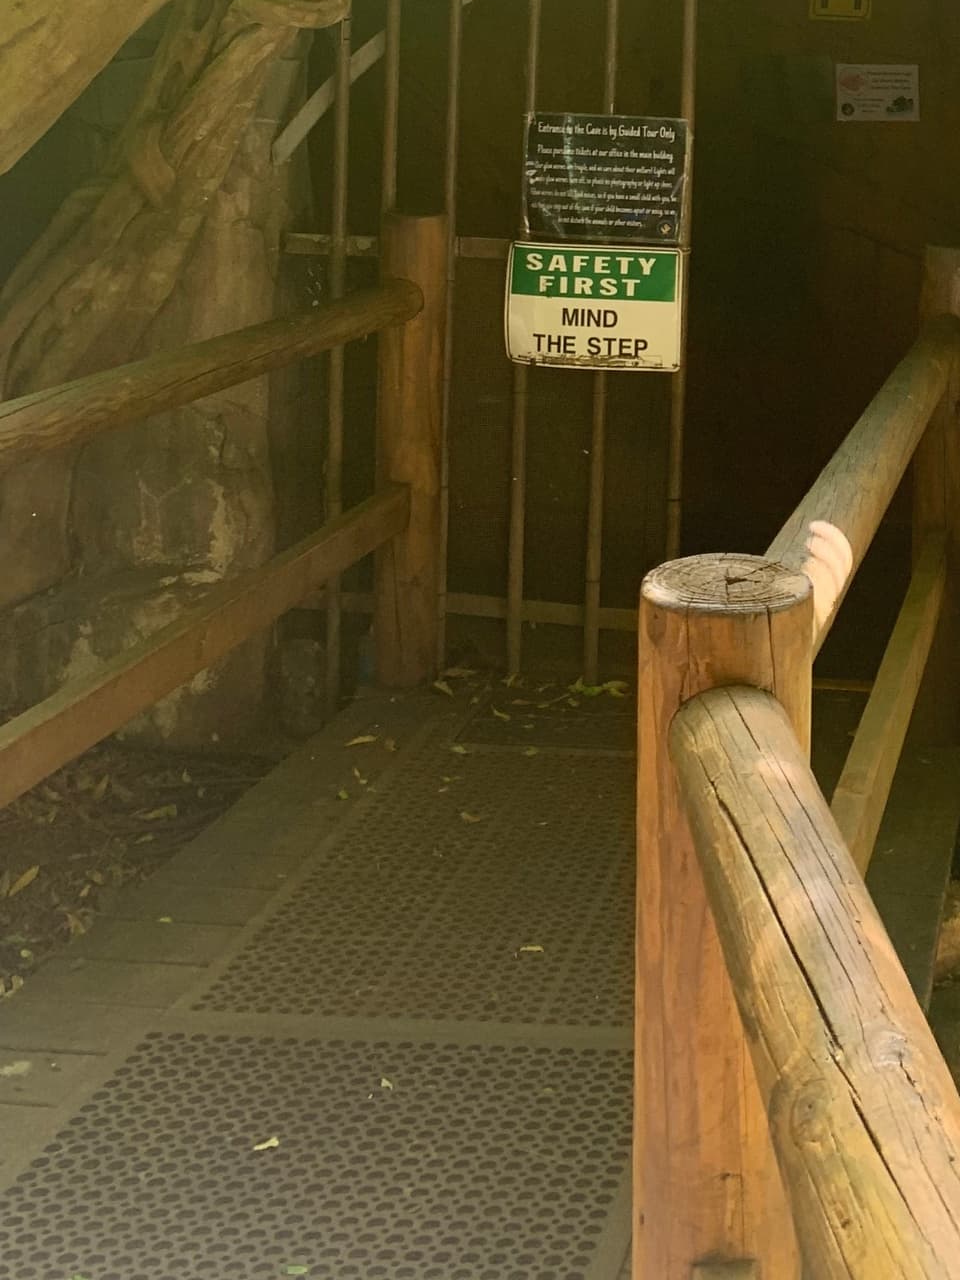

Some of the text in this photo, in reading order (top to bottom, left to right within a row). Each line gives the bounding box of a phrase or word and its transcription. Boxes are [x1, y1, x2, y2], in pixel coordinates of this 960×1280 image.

[537, 121, 565, 134] Entrance
[574, 123, 585, 135] the
[585, 122, 601, 136] Cave
[602, 126, 608, 136] is
[609, 125, 617, 141] by
[618, 124, 641, 137] Guided
[643, 125, 658, 138] Tour
[659, 126, 675, 143] Only
[525, 253, 657, 276] SAFETY
[539, 275, 641, 297] FIRST
[561, 307, 618, 328] MIND
[532, 333, 649, 358] THE STEP
